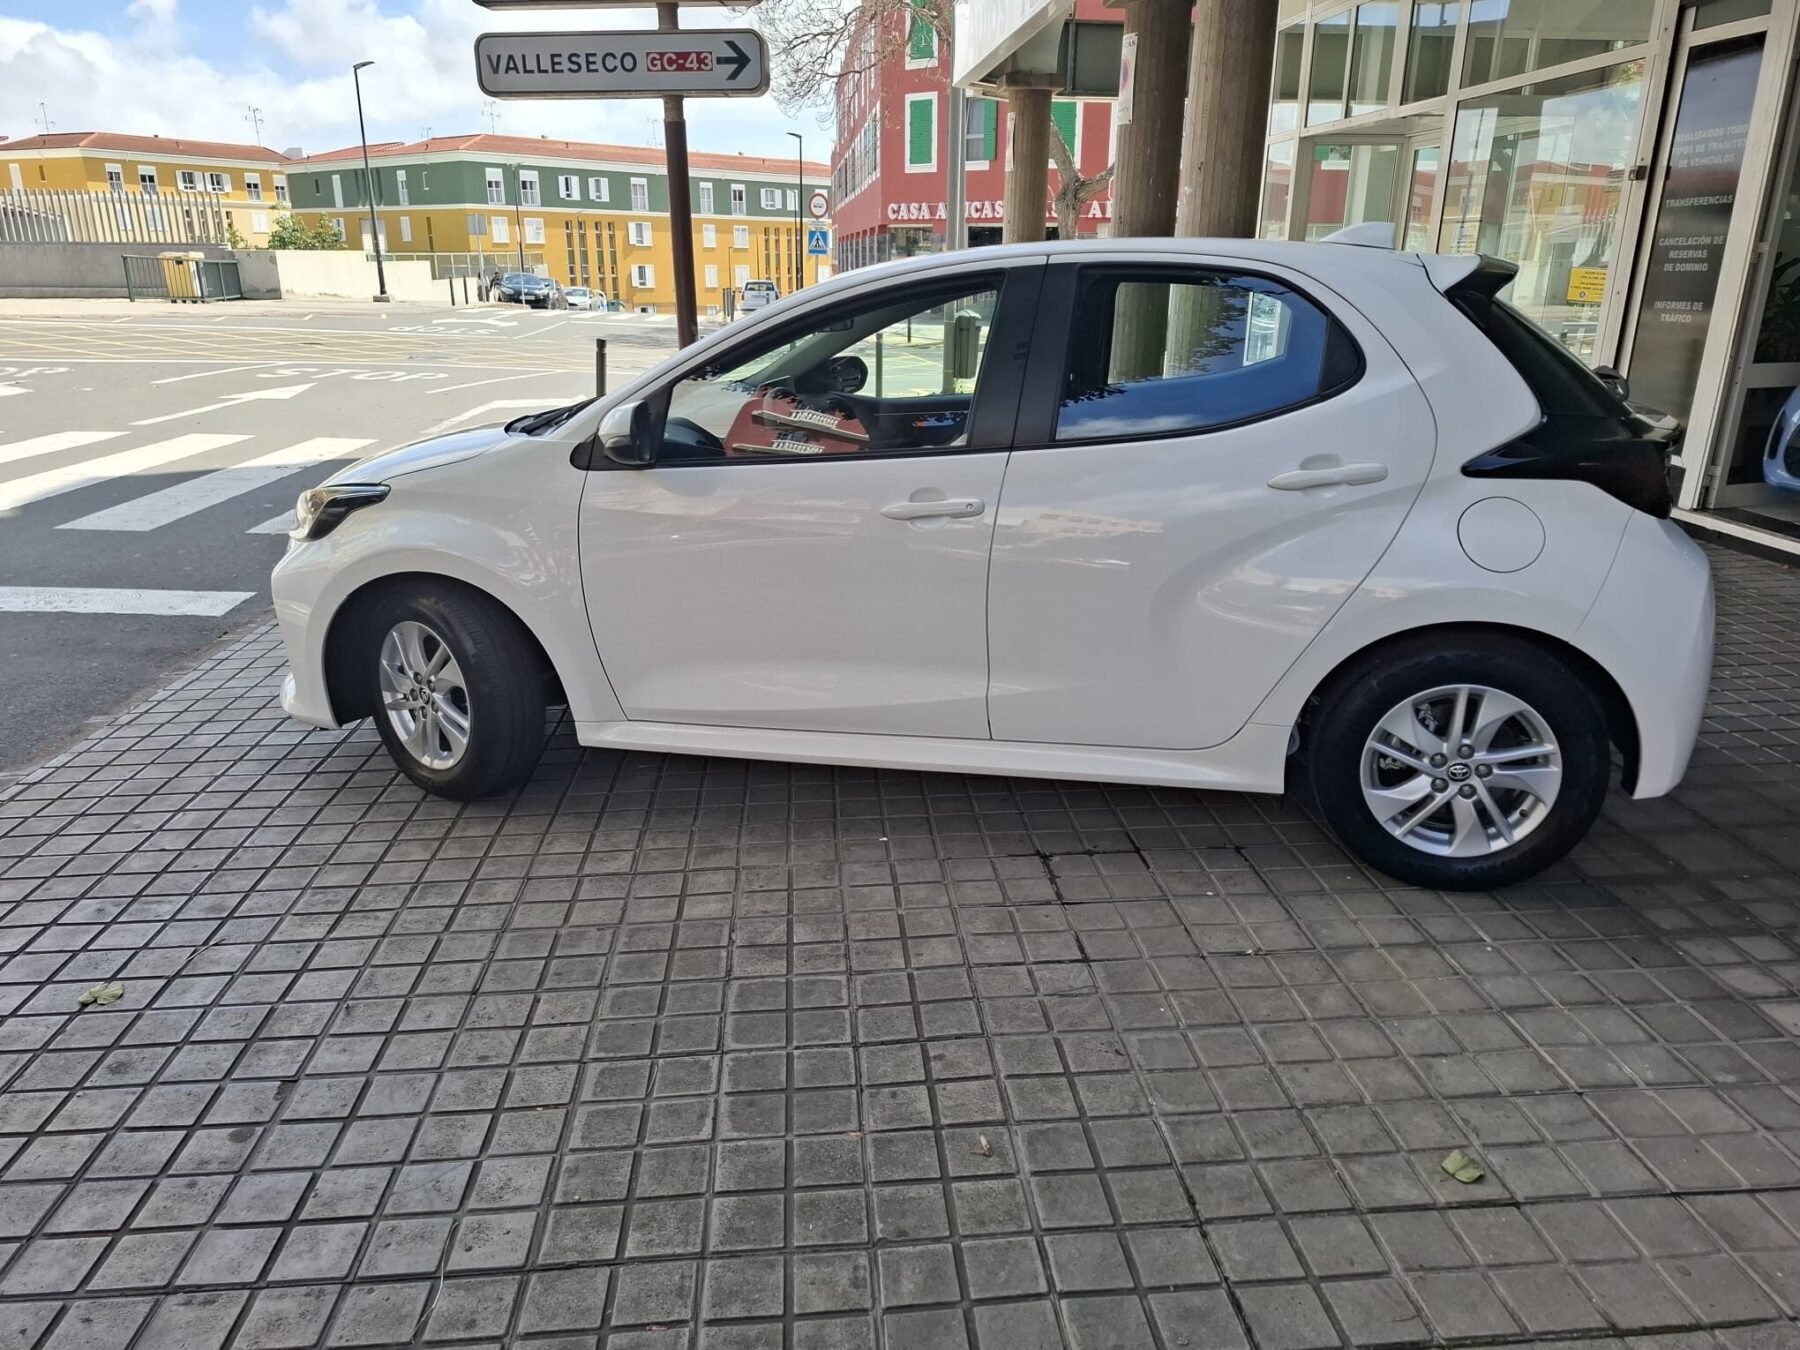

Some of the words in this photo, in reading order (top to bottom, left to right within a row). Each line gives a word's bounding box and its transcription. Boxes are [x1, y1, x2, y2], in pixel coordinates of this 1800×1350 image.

[487, 52, 638, 75] VALLESECO
[647, 51, 713, 72] GC-43
[1666, 194, 1733, 208] TRANSFERENCIAS
[888, 202, 931, 220] CASA
[1659, 235, 1712, 246] CANCELACIÓN
[1713, 235, 1726, 245] DE
[1669, 249, 1708, 259] RESERVAS
[1663, 263, 1674, 272] DE
[1675, 262, 1708, 272] DOMINIO
[1654, 300, 1692, 310] INFORMES
[1693, 301, 1704, 311] DE
[256, 367, 449, 382] STOP
